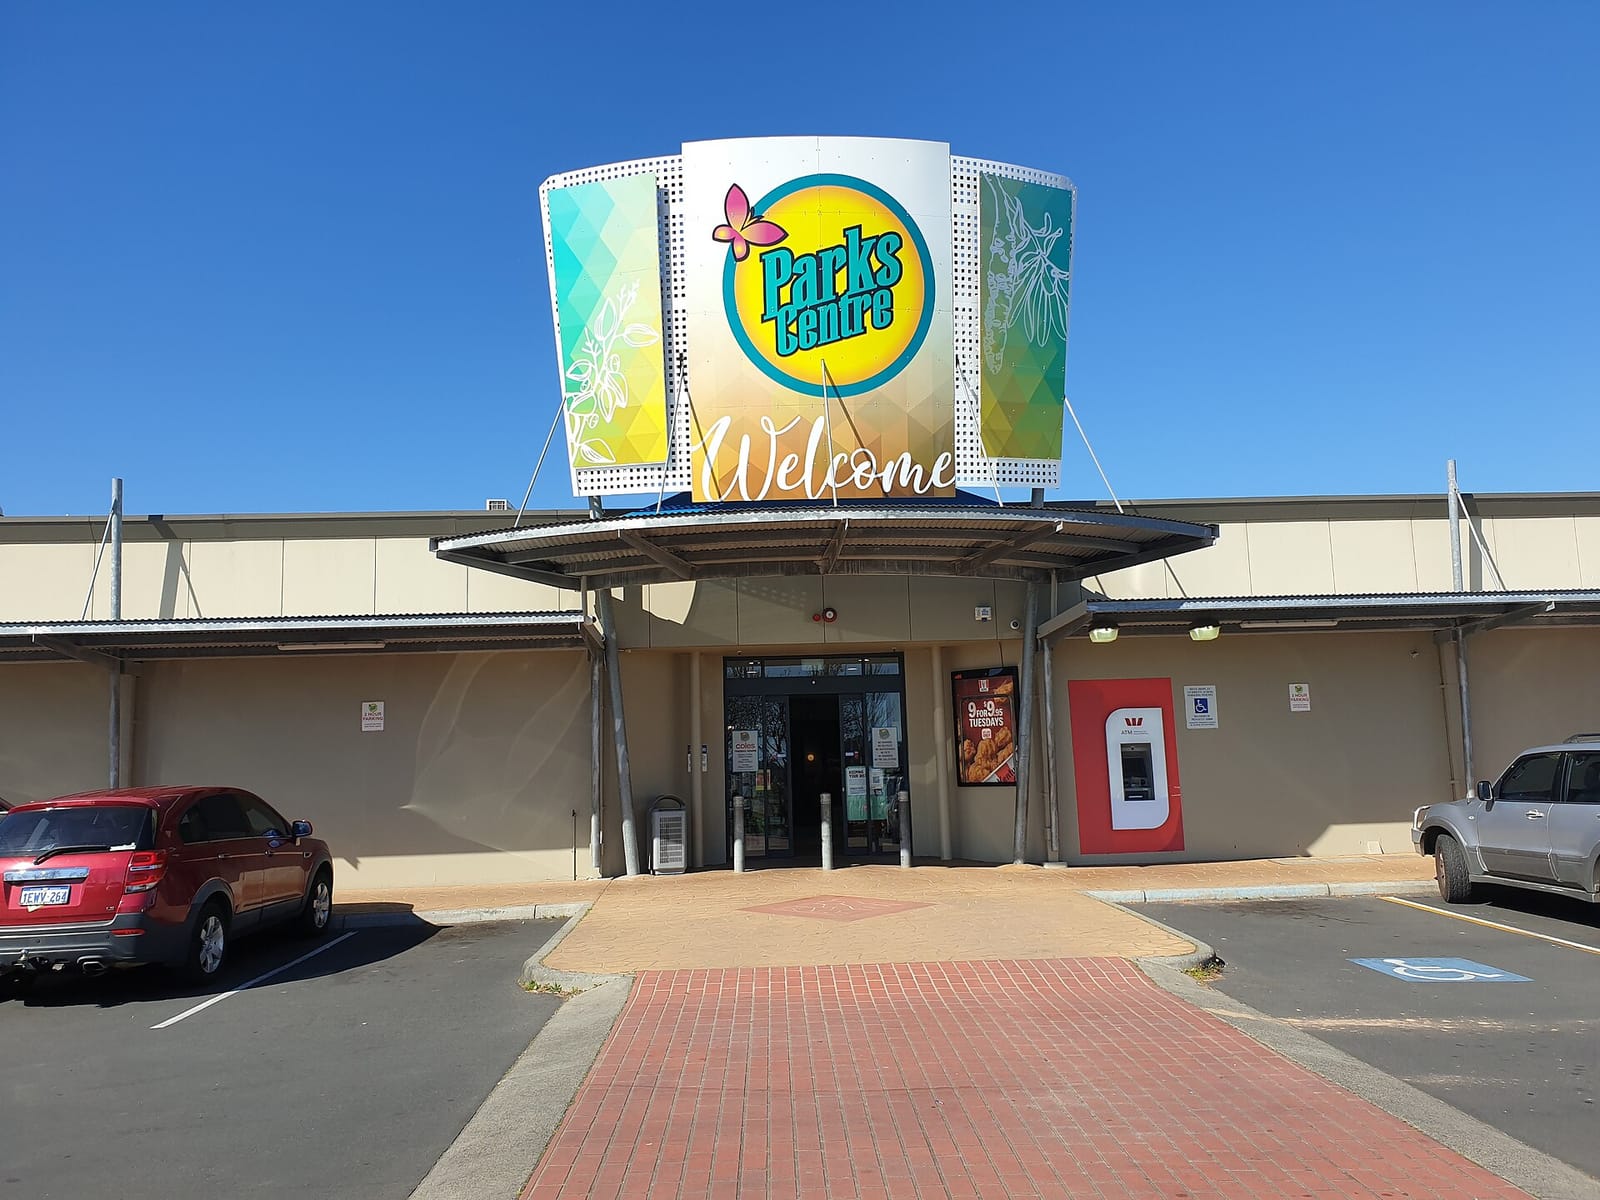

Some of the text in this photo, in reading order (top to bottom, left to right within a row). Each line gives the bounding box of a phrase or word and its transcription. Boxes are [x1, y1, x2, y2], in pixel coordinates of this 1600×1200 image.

[761, 224, 903, 323] Parks
[762, 287, 894, 357] Centre
[691, 415, 956, 501] Welcome
[968, 701, 977, 718] 9
[976, 709, 988, 718] FOR
[969, 717, 1004, 728] TUESDAYS
[735, 742, 756, 750] coles
